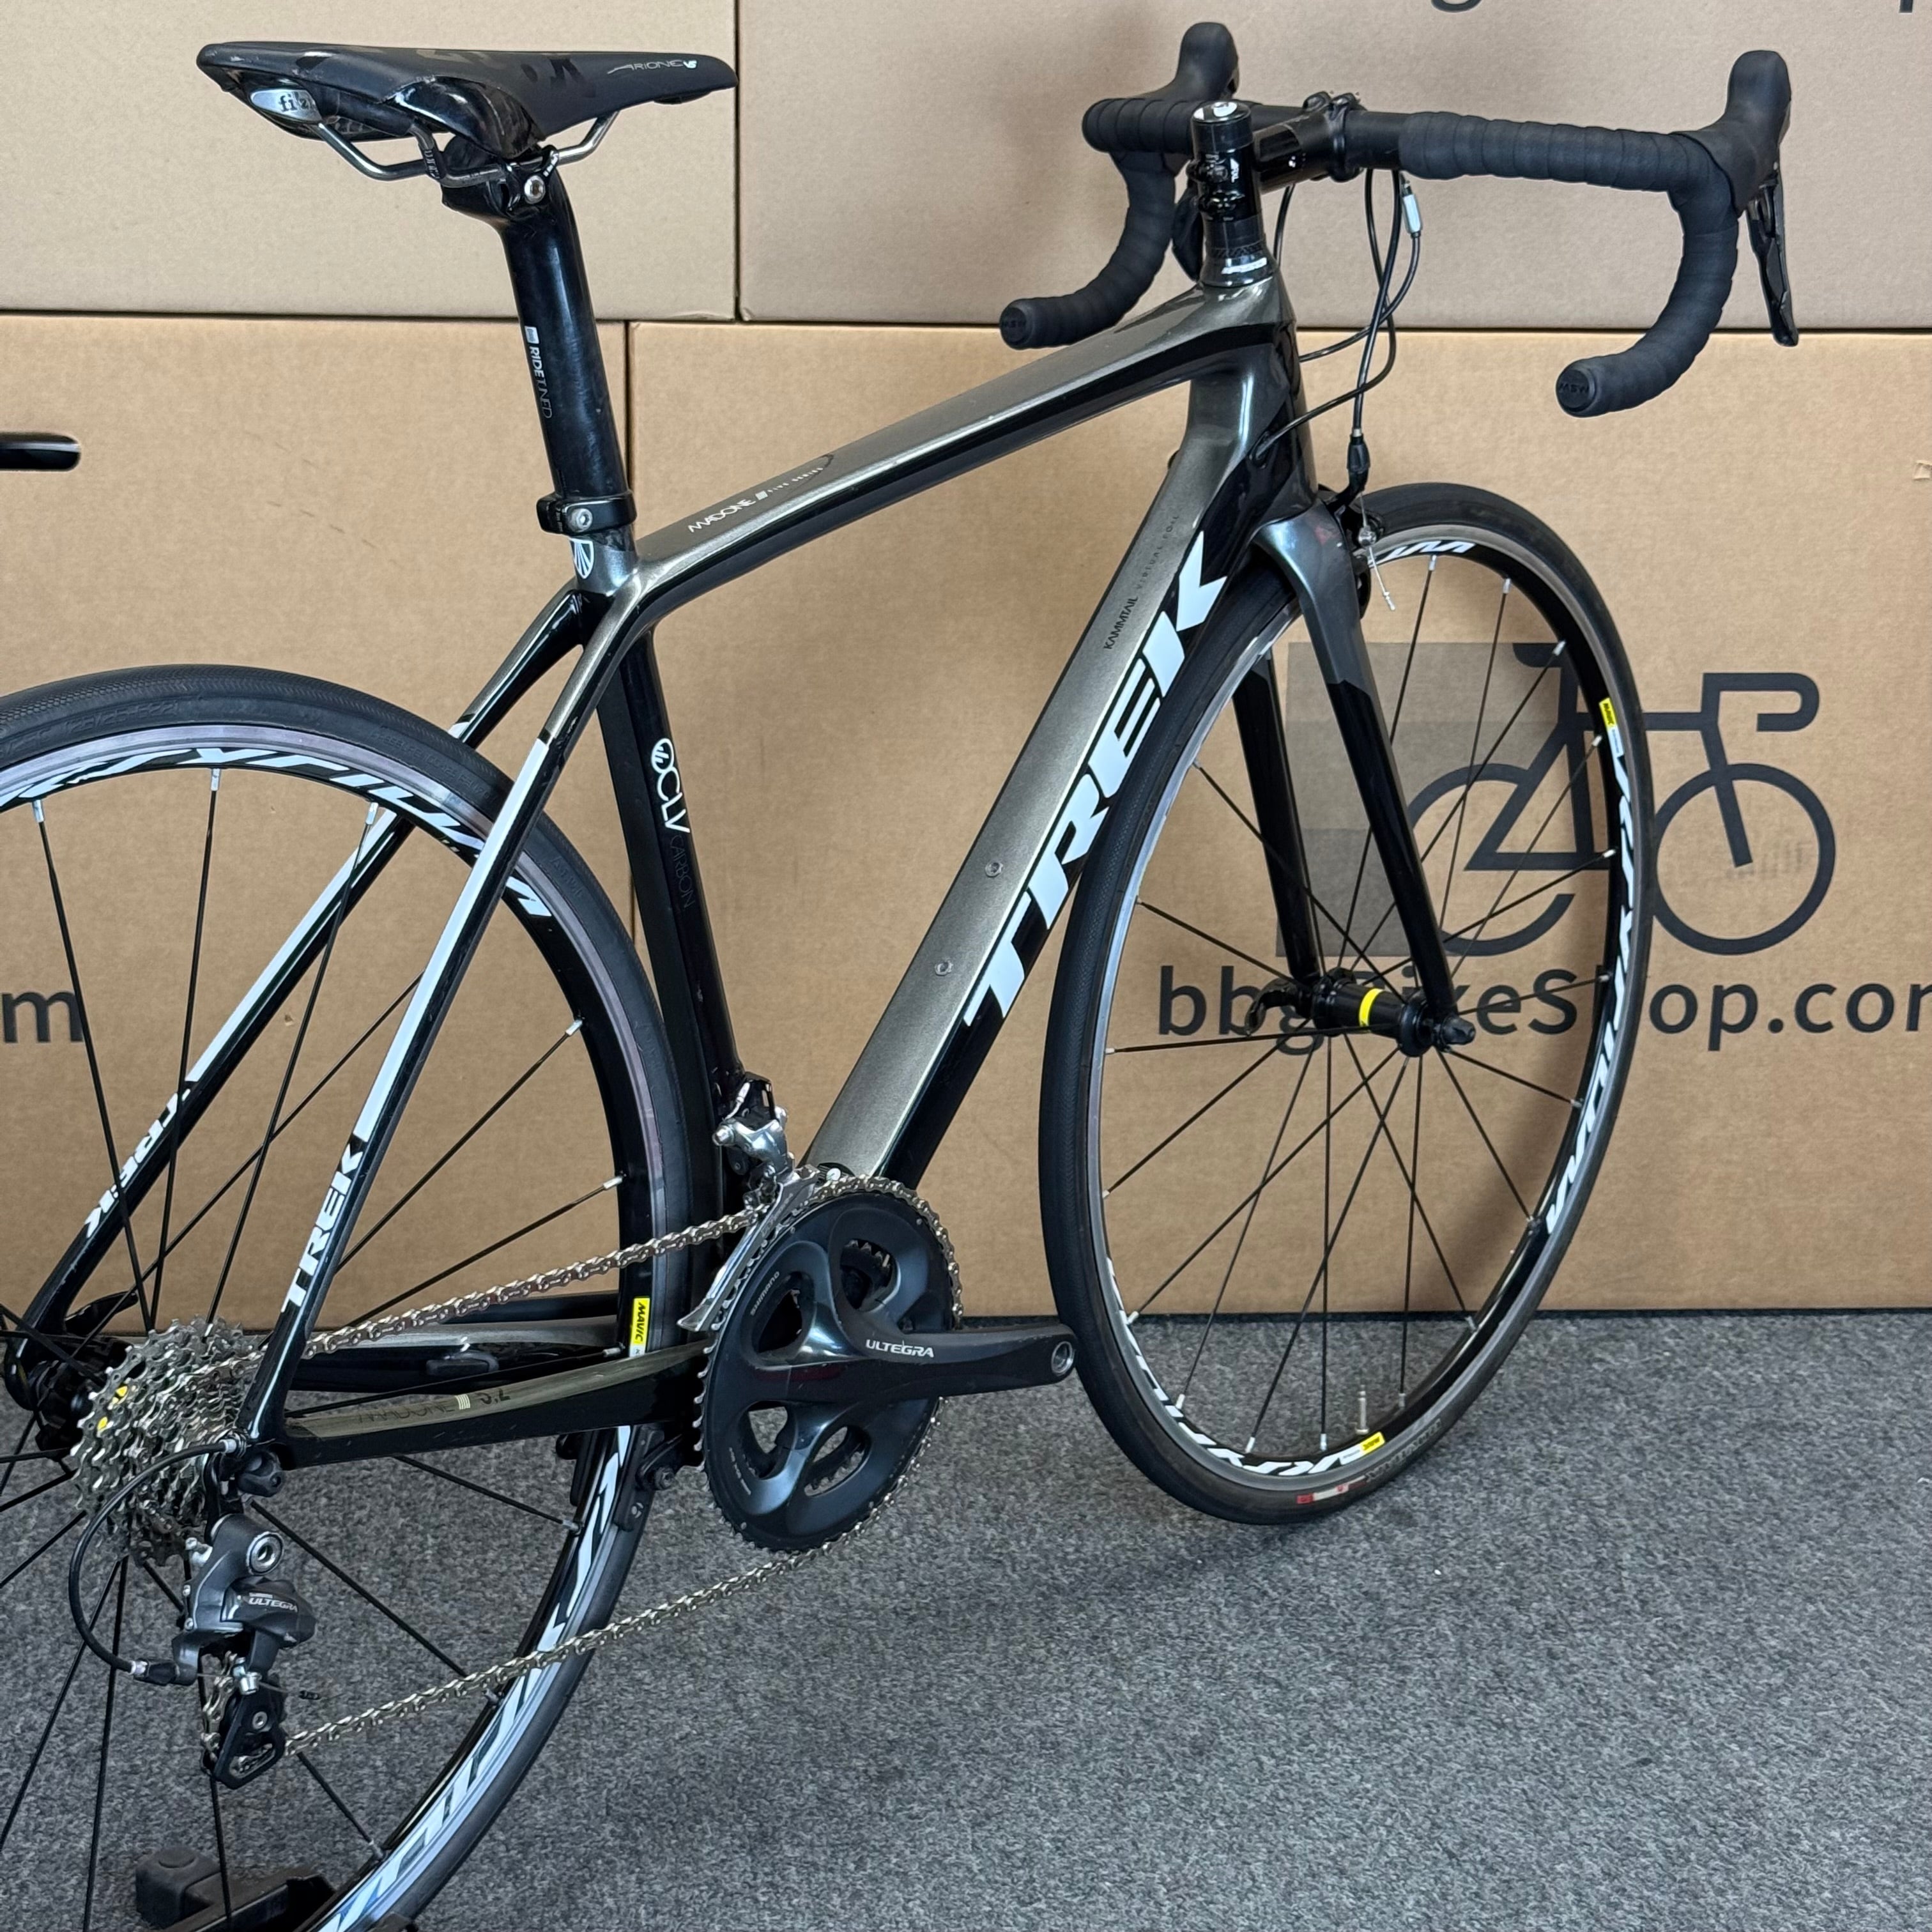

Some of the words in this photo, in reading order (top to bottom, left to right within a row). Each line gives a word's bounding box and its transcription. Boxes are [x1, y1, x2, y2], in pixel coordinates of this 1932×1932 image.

[607, 59, 684, 75] ARIONE
[687, 498, 756, 533] MADONE
[1103, 596, 1138, 650] KAMMTAIL
[963, 530, 1227, 1027] TREK
[280, 1143, 364, 1313] TREK
[635, 1301, 646, 1342] MAVIC
[866, 1339, 934, 1358] ULTEGRA
[249, 1597, 298, 1613] ULTEGRA
